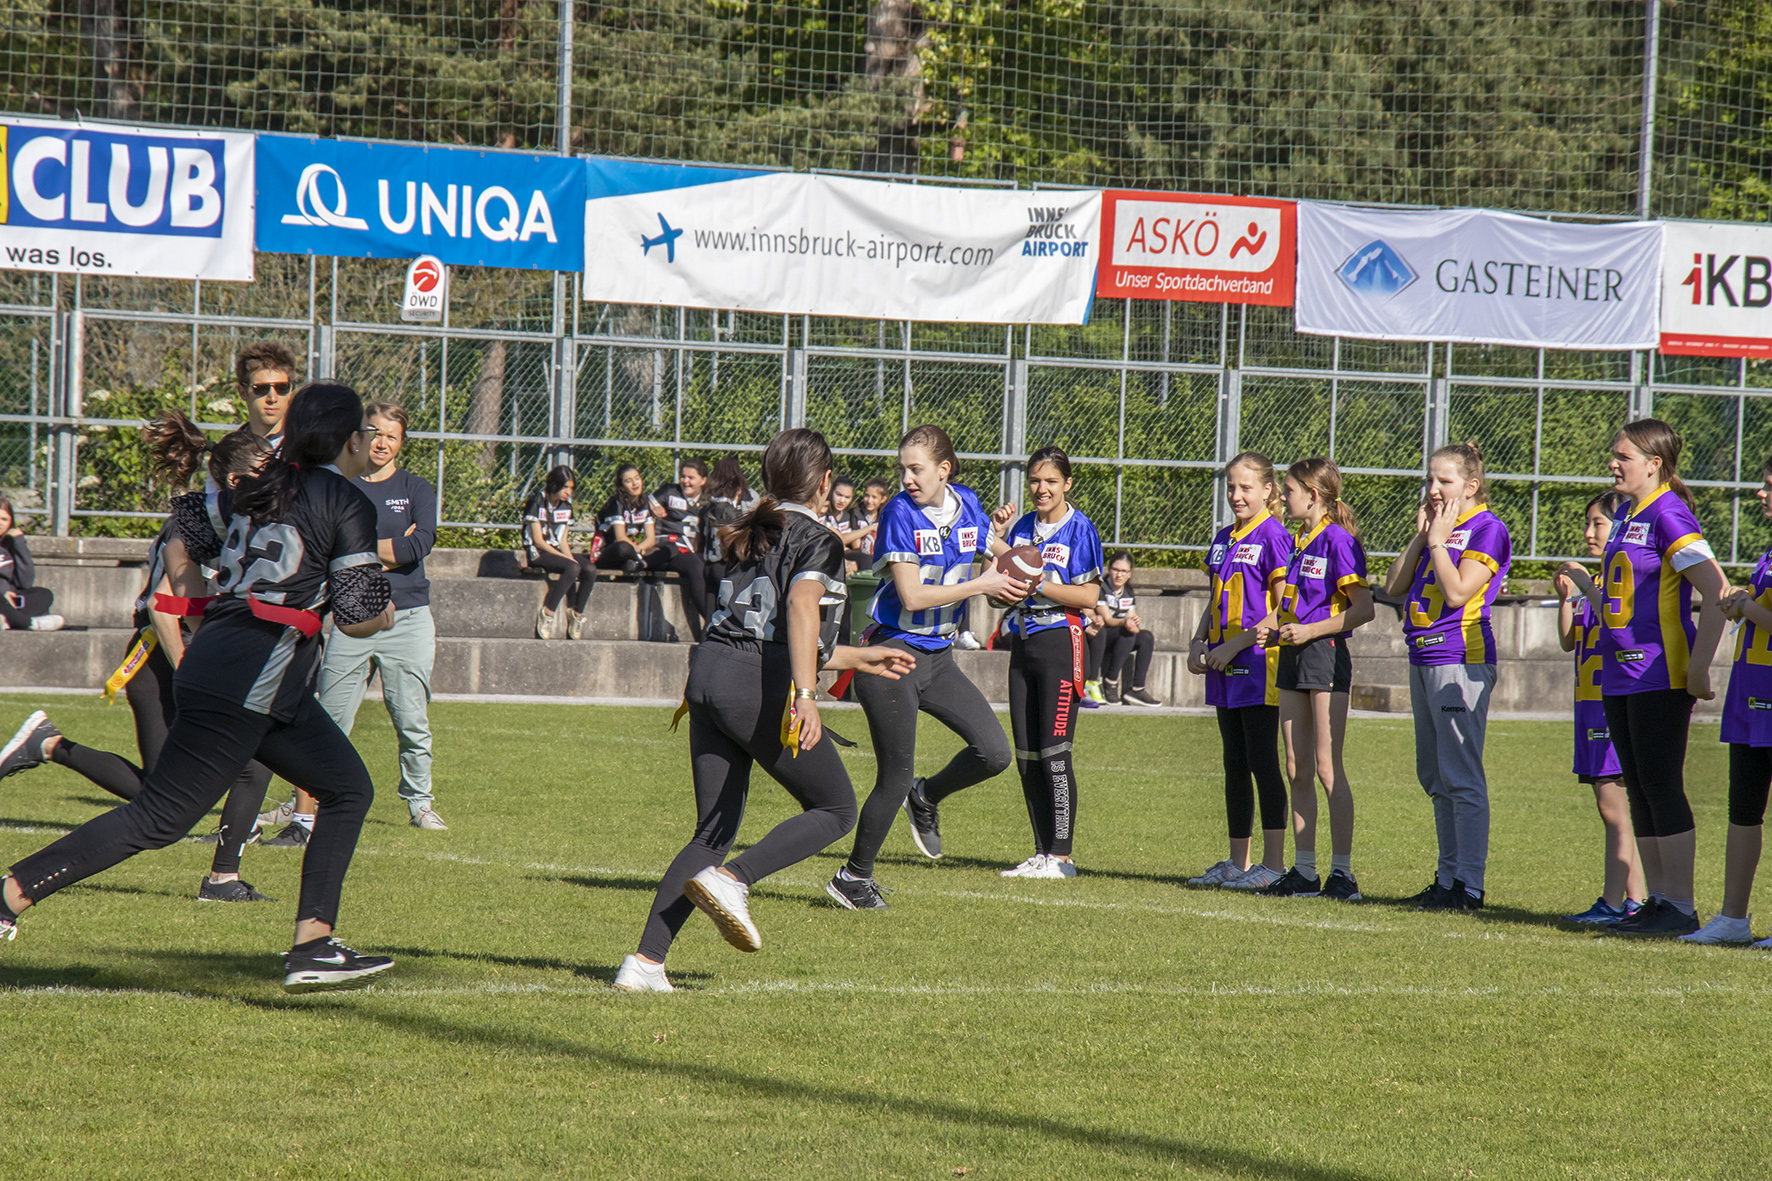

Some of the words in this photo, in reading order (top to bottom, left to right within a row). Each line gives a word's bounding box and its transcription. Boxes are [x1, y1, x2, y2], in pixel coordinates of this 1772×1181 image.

[12, 136, 221, 228] CLUB
[378, 179, 558, 243] UNIQA
[1025, 223, 1077, 239] BRUCK
[694, 226, 995, 268] www.innsbruck-airport.com
[1021, 240, 1089, 257] AIRPORT
[1126, 211, 1220, 257] ASKÖ
[5, 246, 60, 265] was
[70, 245, 112, 268] los.
[1115, 270, 1154, 289] Unser
[1155, 272, 1274, 295] Sportdachverband
[1436, 258, 1623, 302] GASTEINER
[1681, 252, 1772, 308] iKB
[915, 531, 940, 553] iKB
[1042, 552, 1066, 563] BRUCK
[1053, 679, 1073, 737] ATTITUDE
[1051, 760, 1065, 772] IS
[1053, 774, 1070, 839] EVERYTHING
